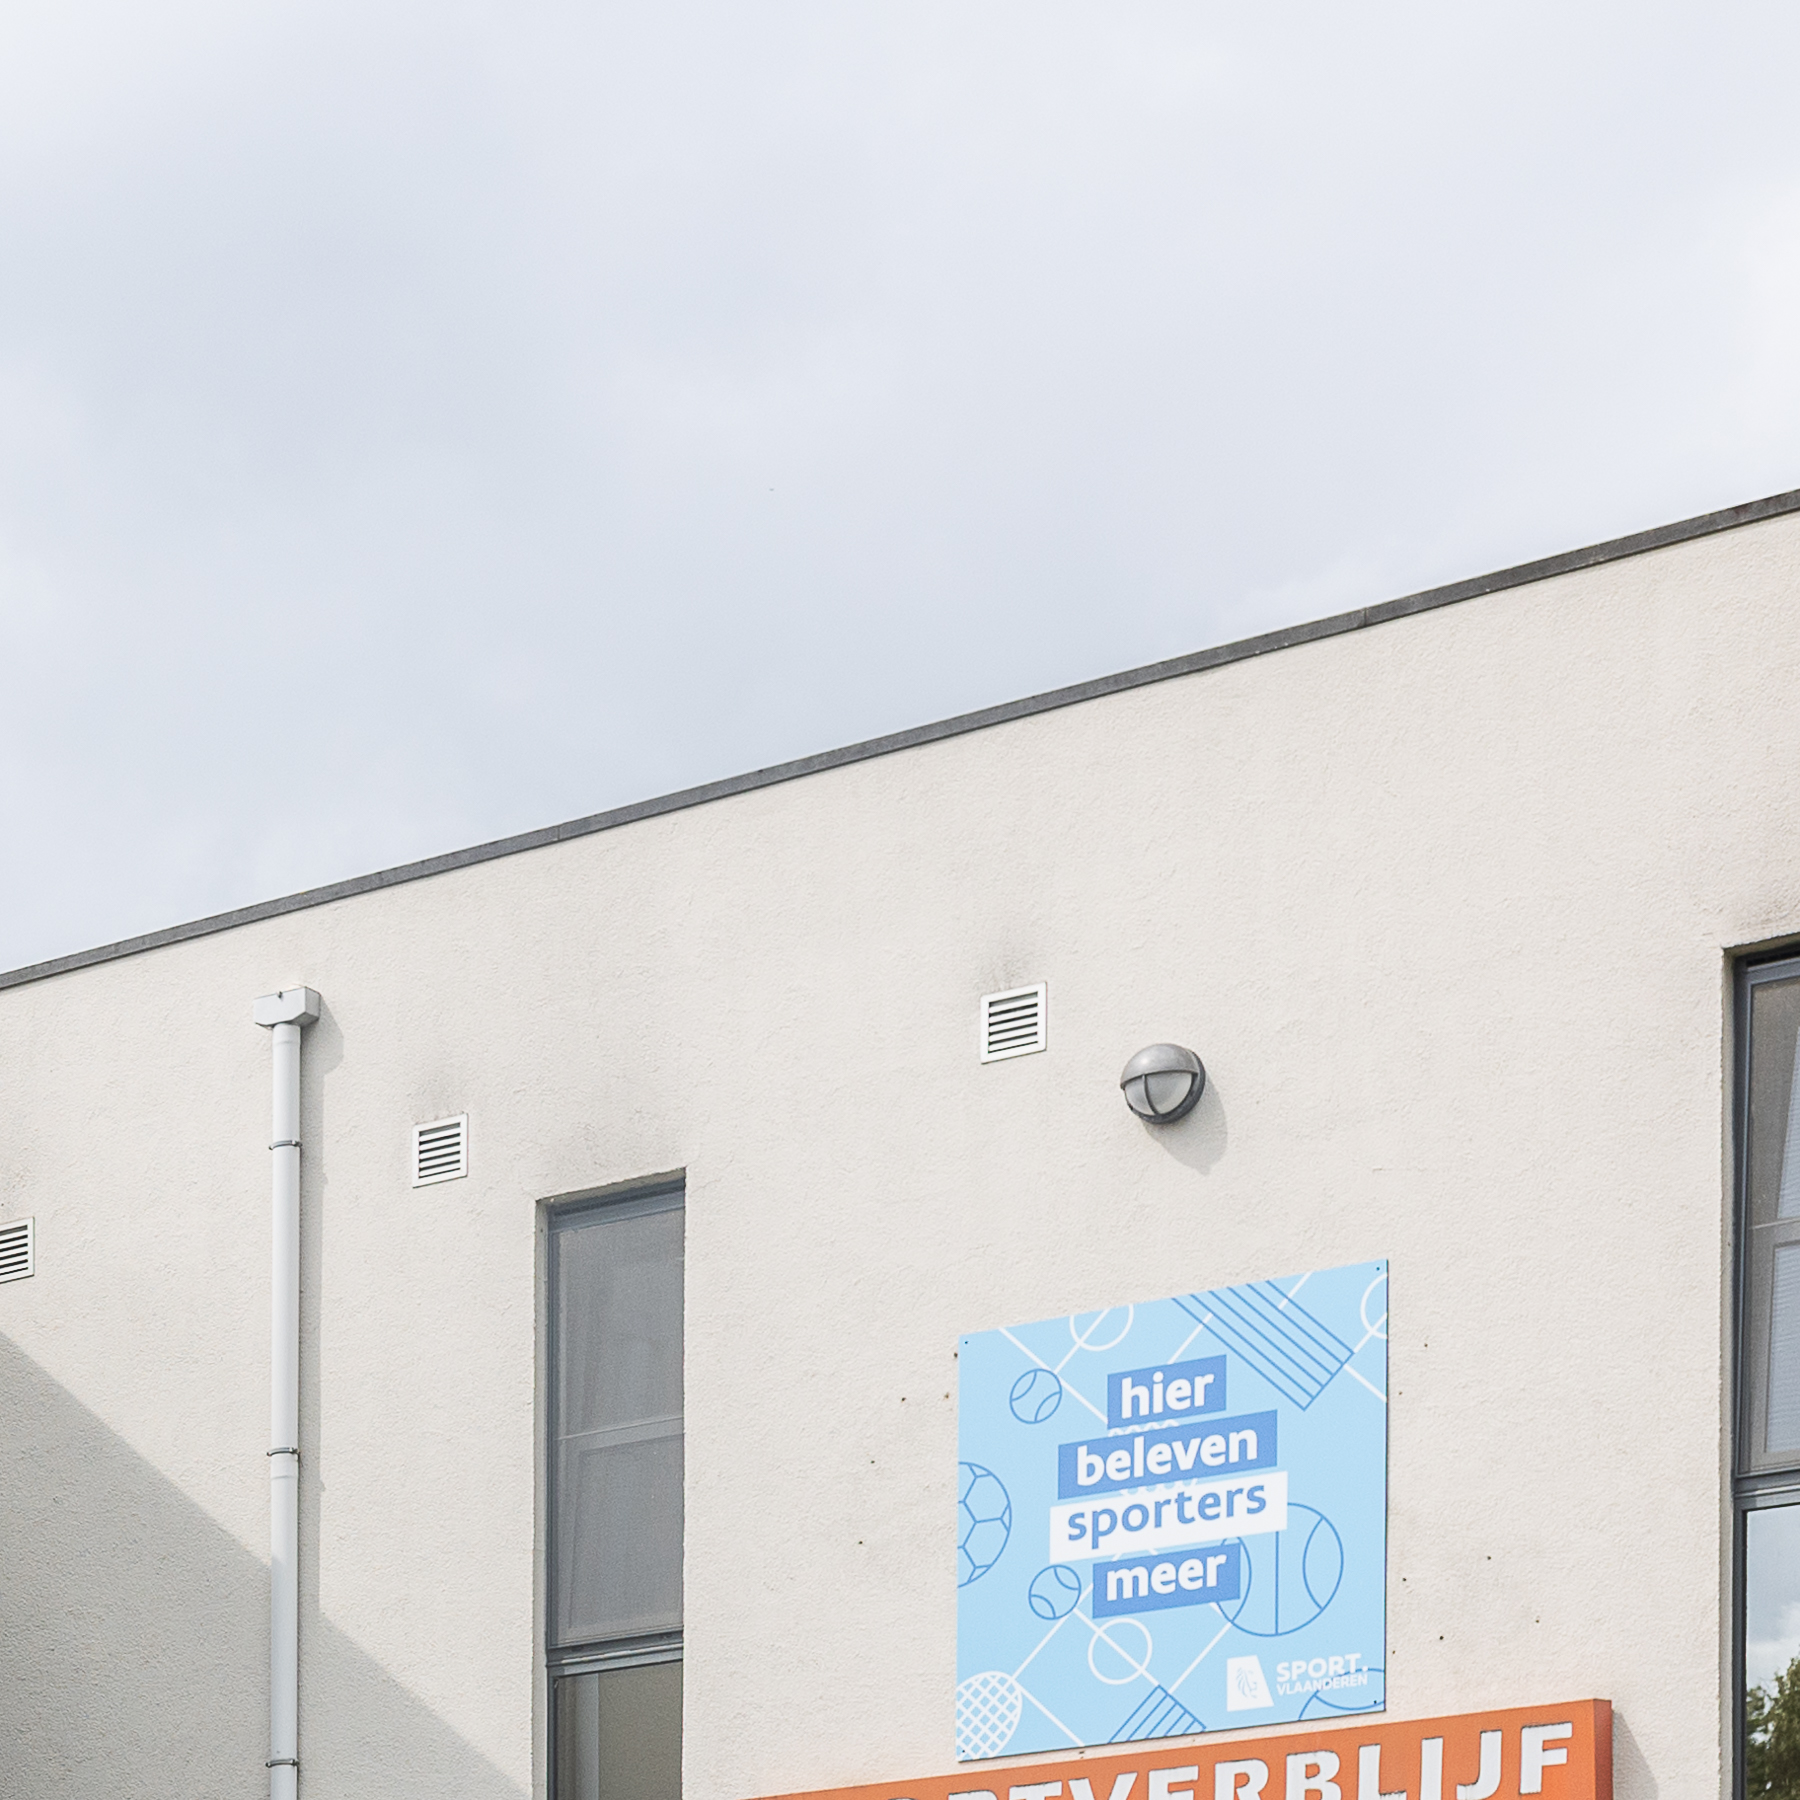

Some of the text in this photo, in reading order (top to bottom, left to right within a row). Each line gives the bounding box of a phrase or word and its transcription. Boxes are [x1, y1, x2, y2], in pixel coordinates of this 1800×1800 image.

[1121, 1371, 1215, 1420] hier
[1076, 1426, 1259, 1487] beleven
[1067, 1484, 1268, 1550] sporters
[1106, 1553, 1228, 1602] meer
[1276, 1653, 1369, 1683] SPORT.
[1276, 1673, 1369, 1696] VLAANDEREN
